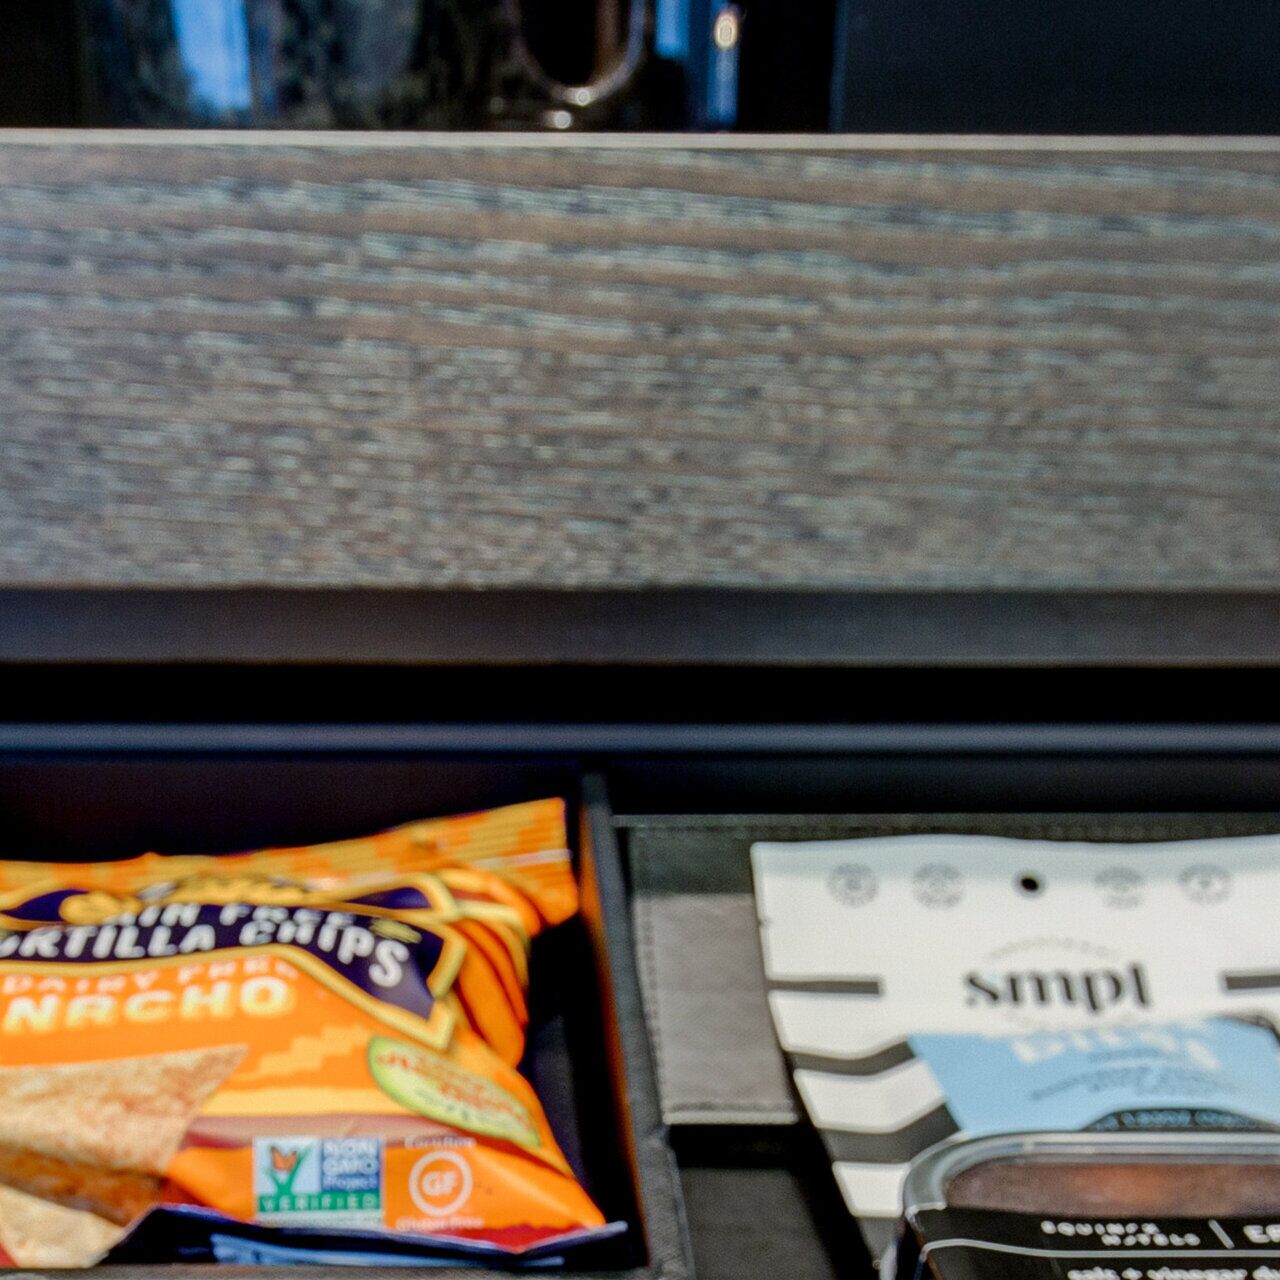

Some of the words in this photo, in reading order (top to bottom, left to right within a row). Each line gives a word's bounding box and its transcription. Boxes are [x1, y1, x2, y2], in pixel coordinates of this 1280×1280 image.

[239, 918, 409, 988] CHIPS
[2, 976, 291, 1034] NACHO
[962, 961, 1153, 1015] smpl
